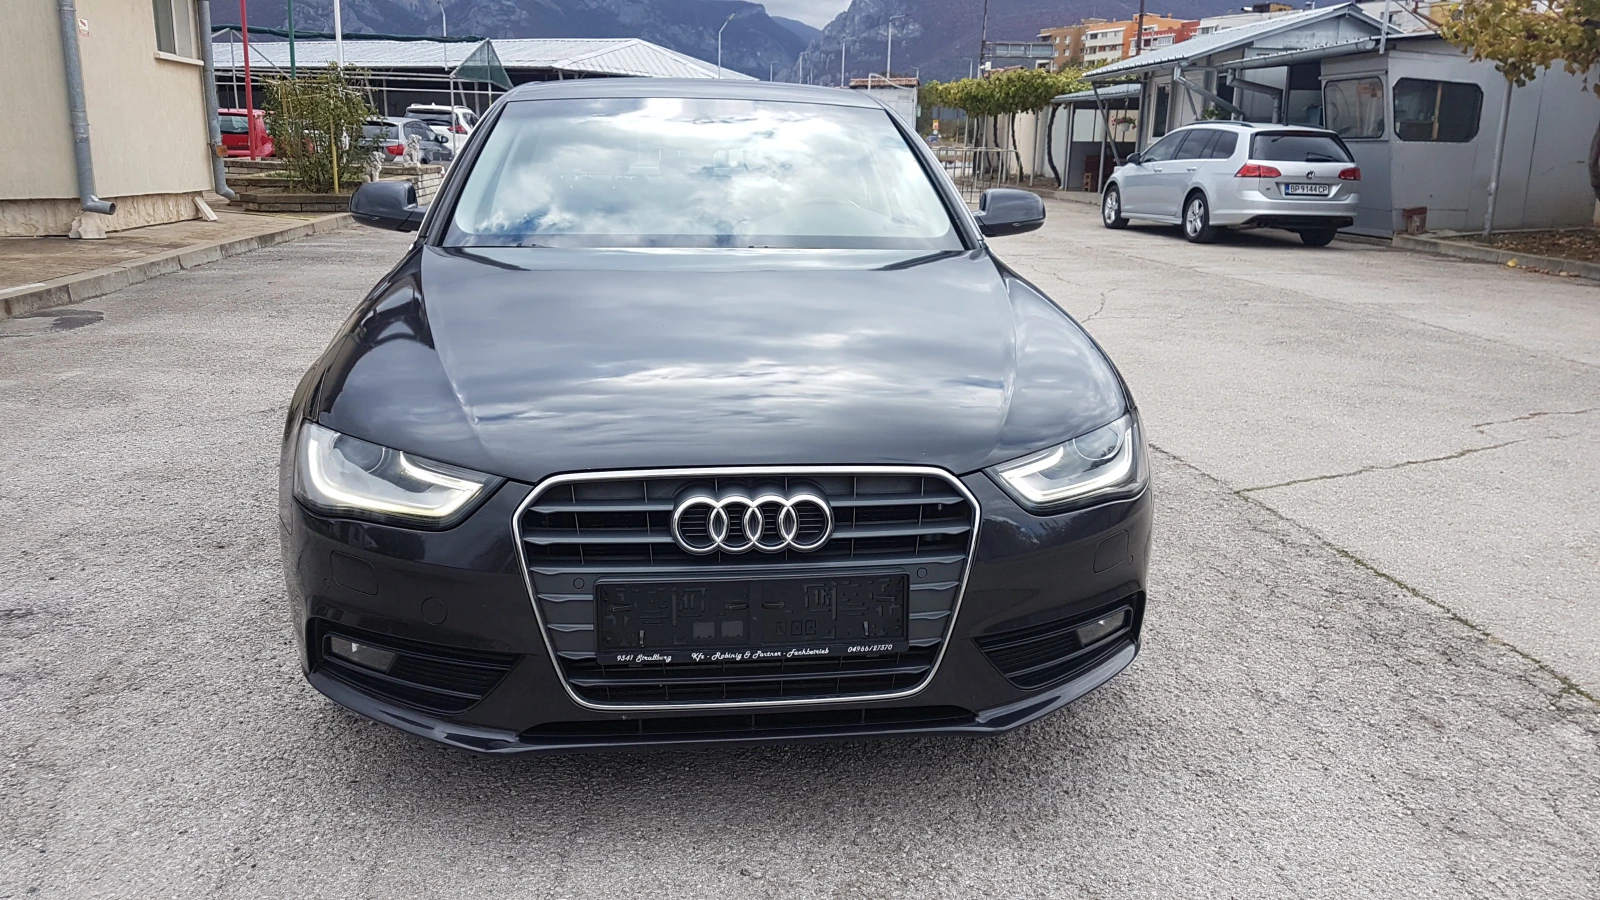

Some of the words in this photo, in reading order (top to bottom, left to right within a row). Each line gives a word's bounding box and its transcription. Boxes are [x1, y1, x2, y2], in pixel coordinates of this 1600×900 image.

[1300, 185, 1317, 193] 9144
[1318, 185, 1328, 193] CP
[691, 652, 705, 662] Kfz
[752, 650, 781, 660] Partner
[786, 646, 830, 658] Fachbetrieb
